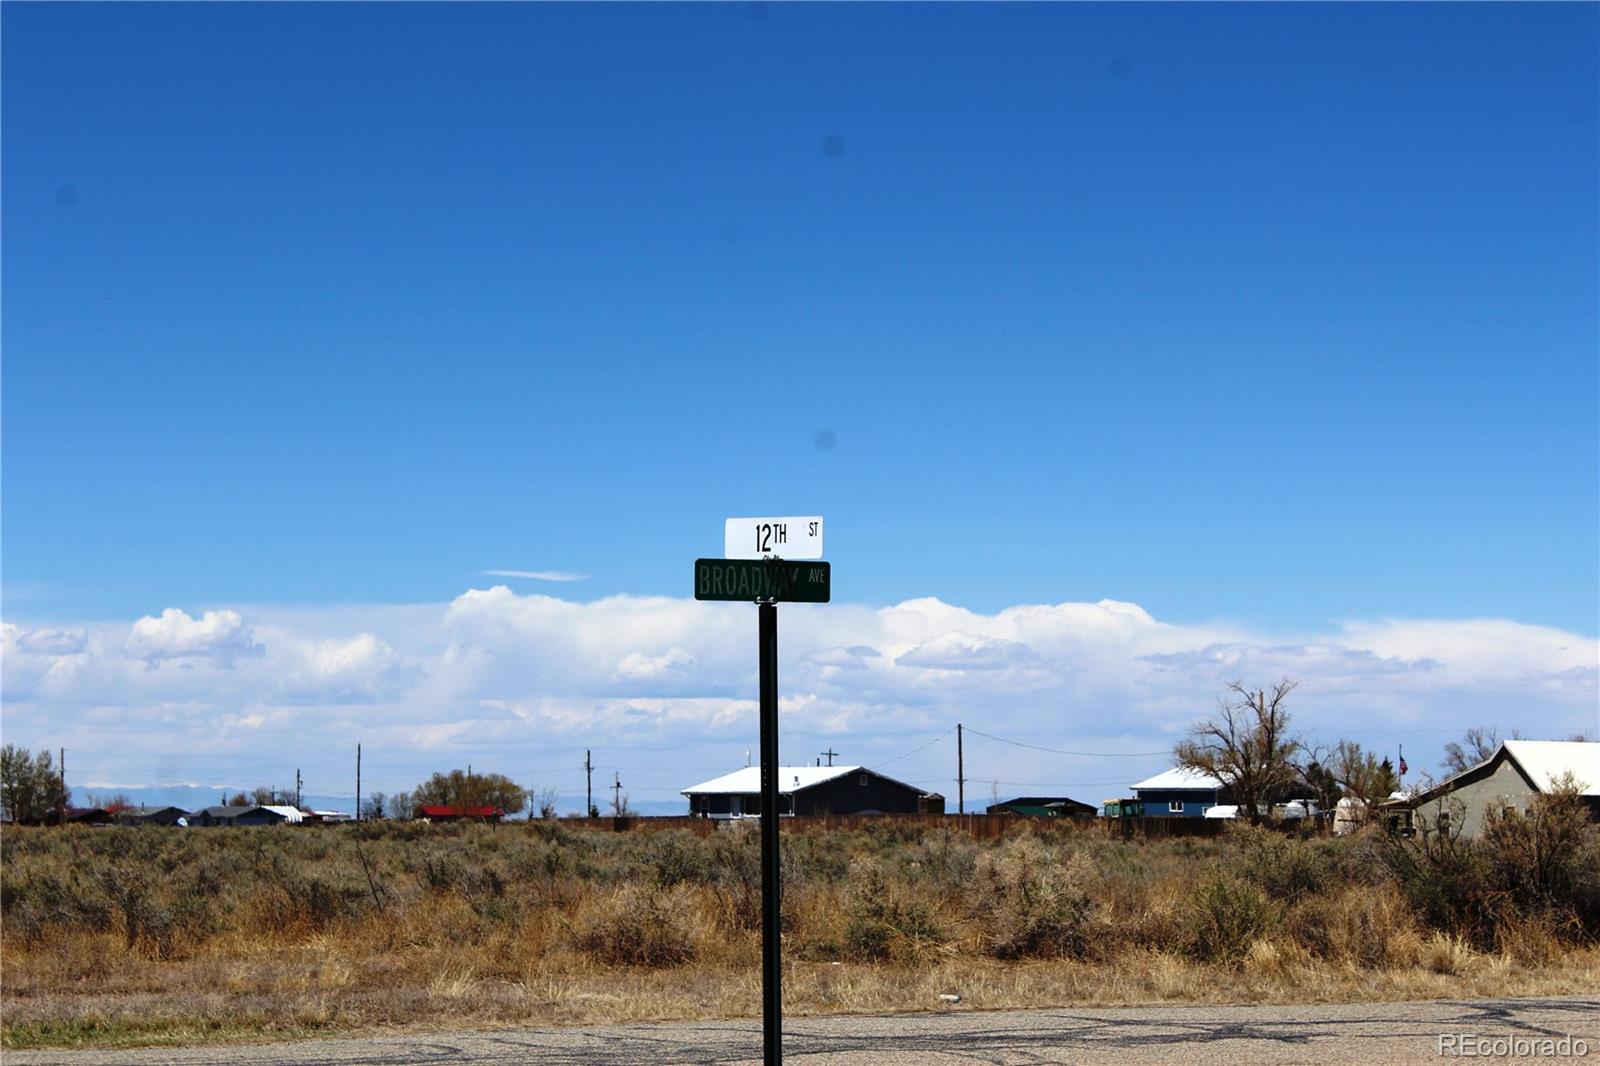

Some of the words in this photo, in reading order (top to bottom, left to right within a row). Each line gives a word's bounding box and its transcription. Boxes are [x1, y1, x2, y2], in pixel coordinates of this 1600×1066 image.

[756, 523, 787, 553] 12TH
[808, 522, 819, 537] ST
[699, 565, 800, 595] BROADWAY
[808, 568, 825, 583] AVE
